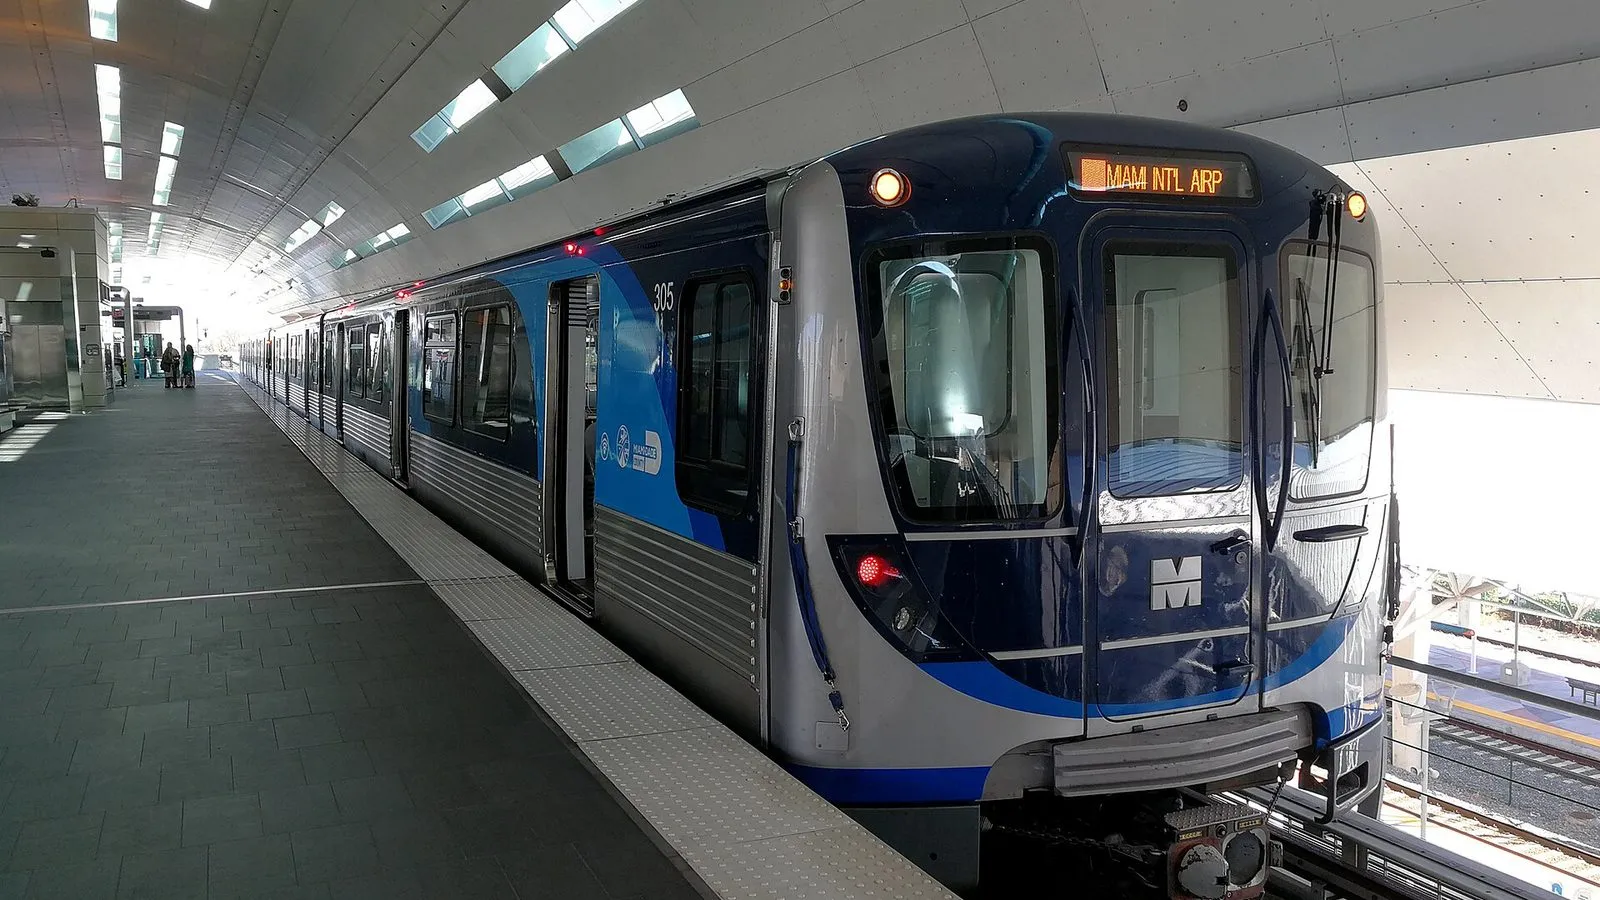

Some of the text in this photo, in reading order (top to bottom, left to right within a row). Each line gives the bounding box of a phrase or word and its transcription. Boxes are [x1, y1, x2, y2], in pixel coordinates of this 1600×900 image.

[1106, 164, 1223, 194] MIAMI INT'L AIRP
[653, 281, 674, 312] 305
